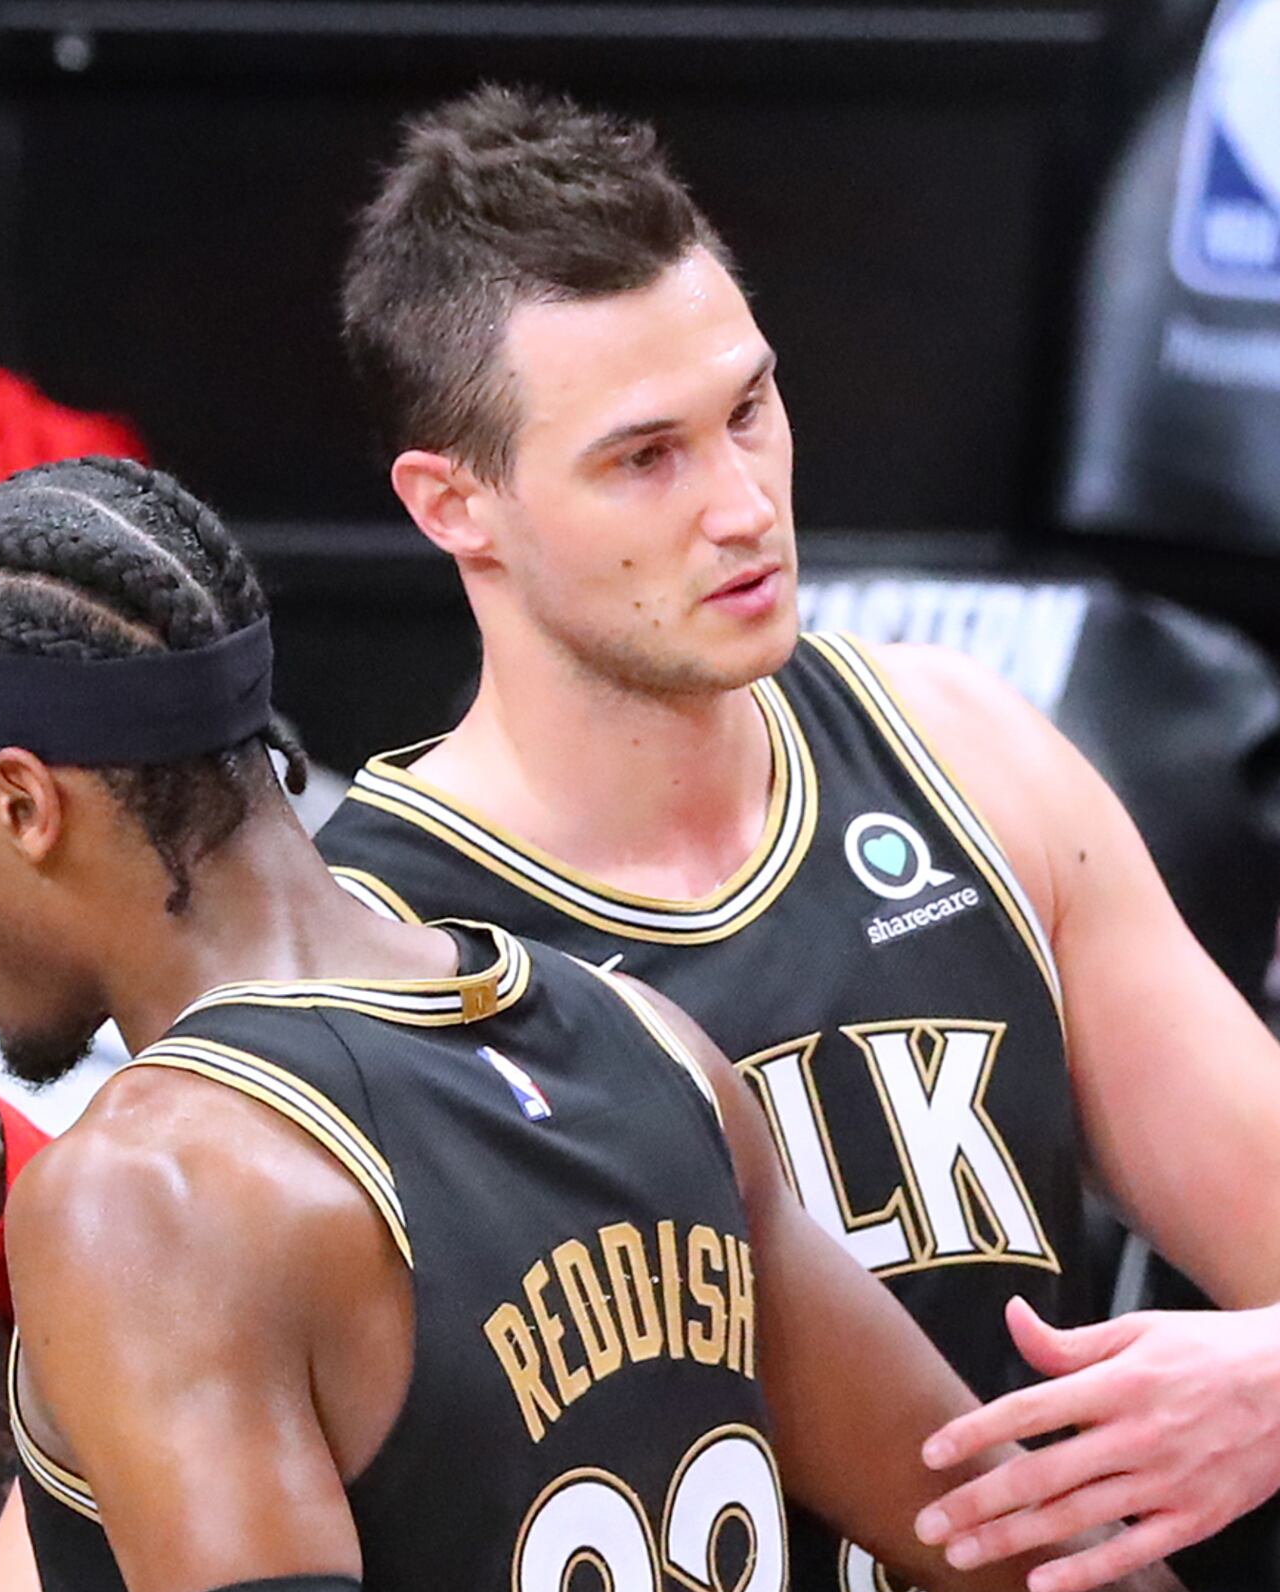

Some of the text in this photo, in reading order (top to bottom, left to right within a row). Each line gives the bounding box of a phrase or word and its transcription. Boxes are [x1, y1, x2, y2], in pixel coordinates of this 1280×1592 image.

[867, 887, 980, 944] sharecare
[731, 1017, 1063, 1282] LK
[483, 1220, 757, 1442] REDDISH
